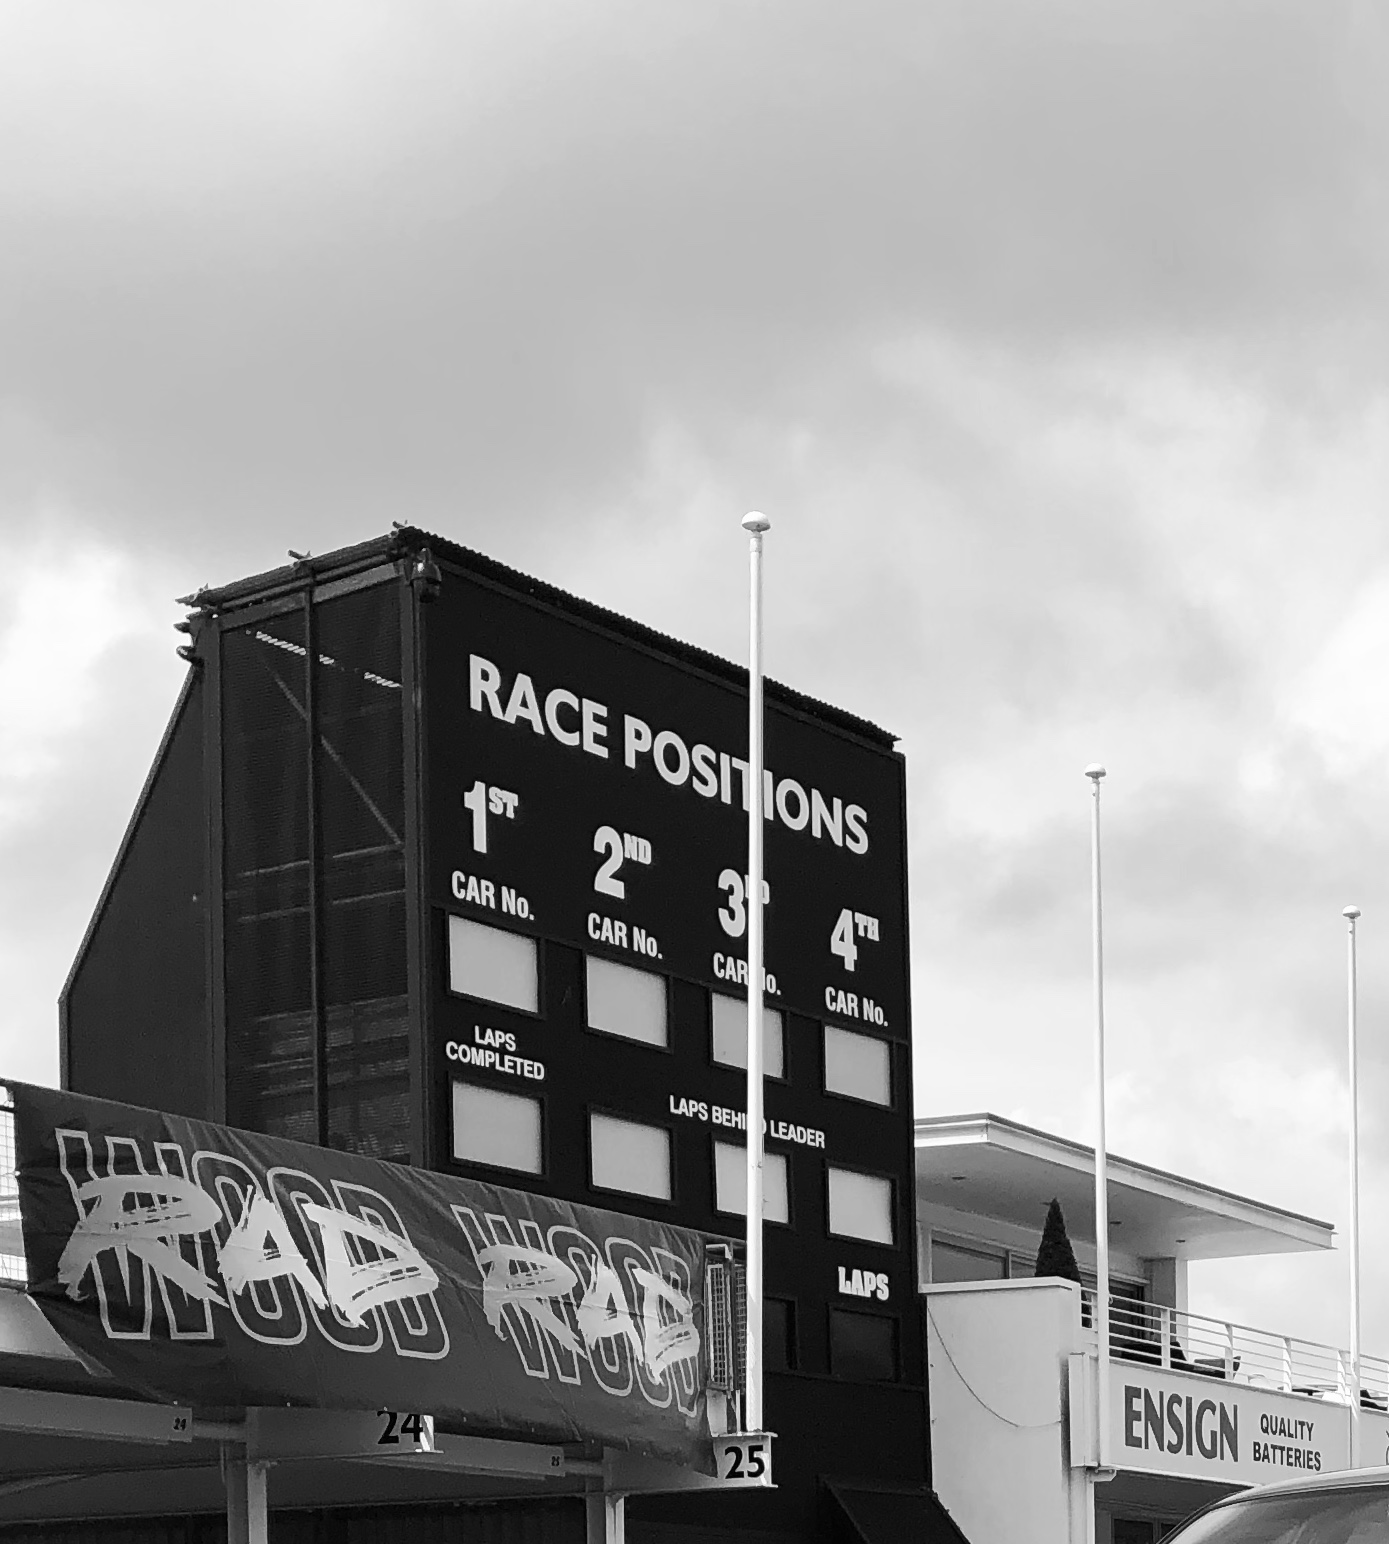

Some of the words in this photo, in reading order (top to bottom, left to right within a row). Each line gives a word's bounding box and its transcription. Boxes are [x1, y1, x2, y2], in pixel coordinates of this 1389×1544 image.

[469, 653, 609, 759] RACE
[463, 780, 519, 854] 1ST
[593, 825, 652, 900] 2ND
[451, 870, 496, 910] CAR
[501, 885, 535, 921] No.
[587, 912, 628, 949] CAR
[632, 926, 663, 960] No.
[830, 908, 880, 972] 4TH
[713, 952, 749, 986] CAR
[762, 967, 782, 996] o.
[825, 986, 860, 1015] CAR
[862, 997, 889, 1027] No.
[445, 1040, 545, 1081] COMPLETED
[474, 1025, 517, 1052] LAPS
[669, 1094, 709, 1121] LAPS
[769, 1119, 826, 1149] LEADER
[58, 1184, 440, 1329] RAD
[837, 1266, 890, 1301] LAPS
[377, 1410, 423, 1445] 24
[1123, 1385, 1240, 1463] ENSIGN
[1260, 1413, 1315, 1442] QUALITY
[725, 1445, 765, 1480] 25
[1252, 1441, 1322, 1472] BATTERIES
